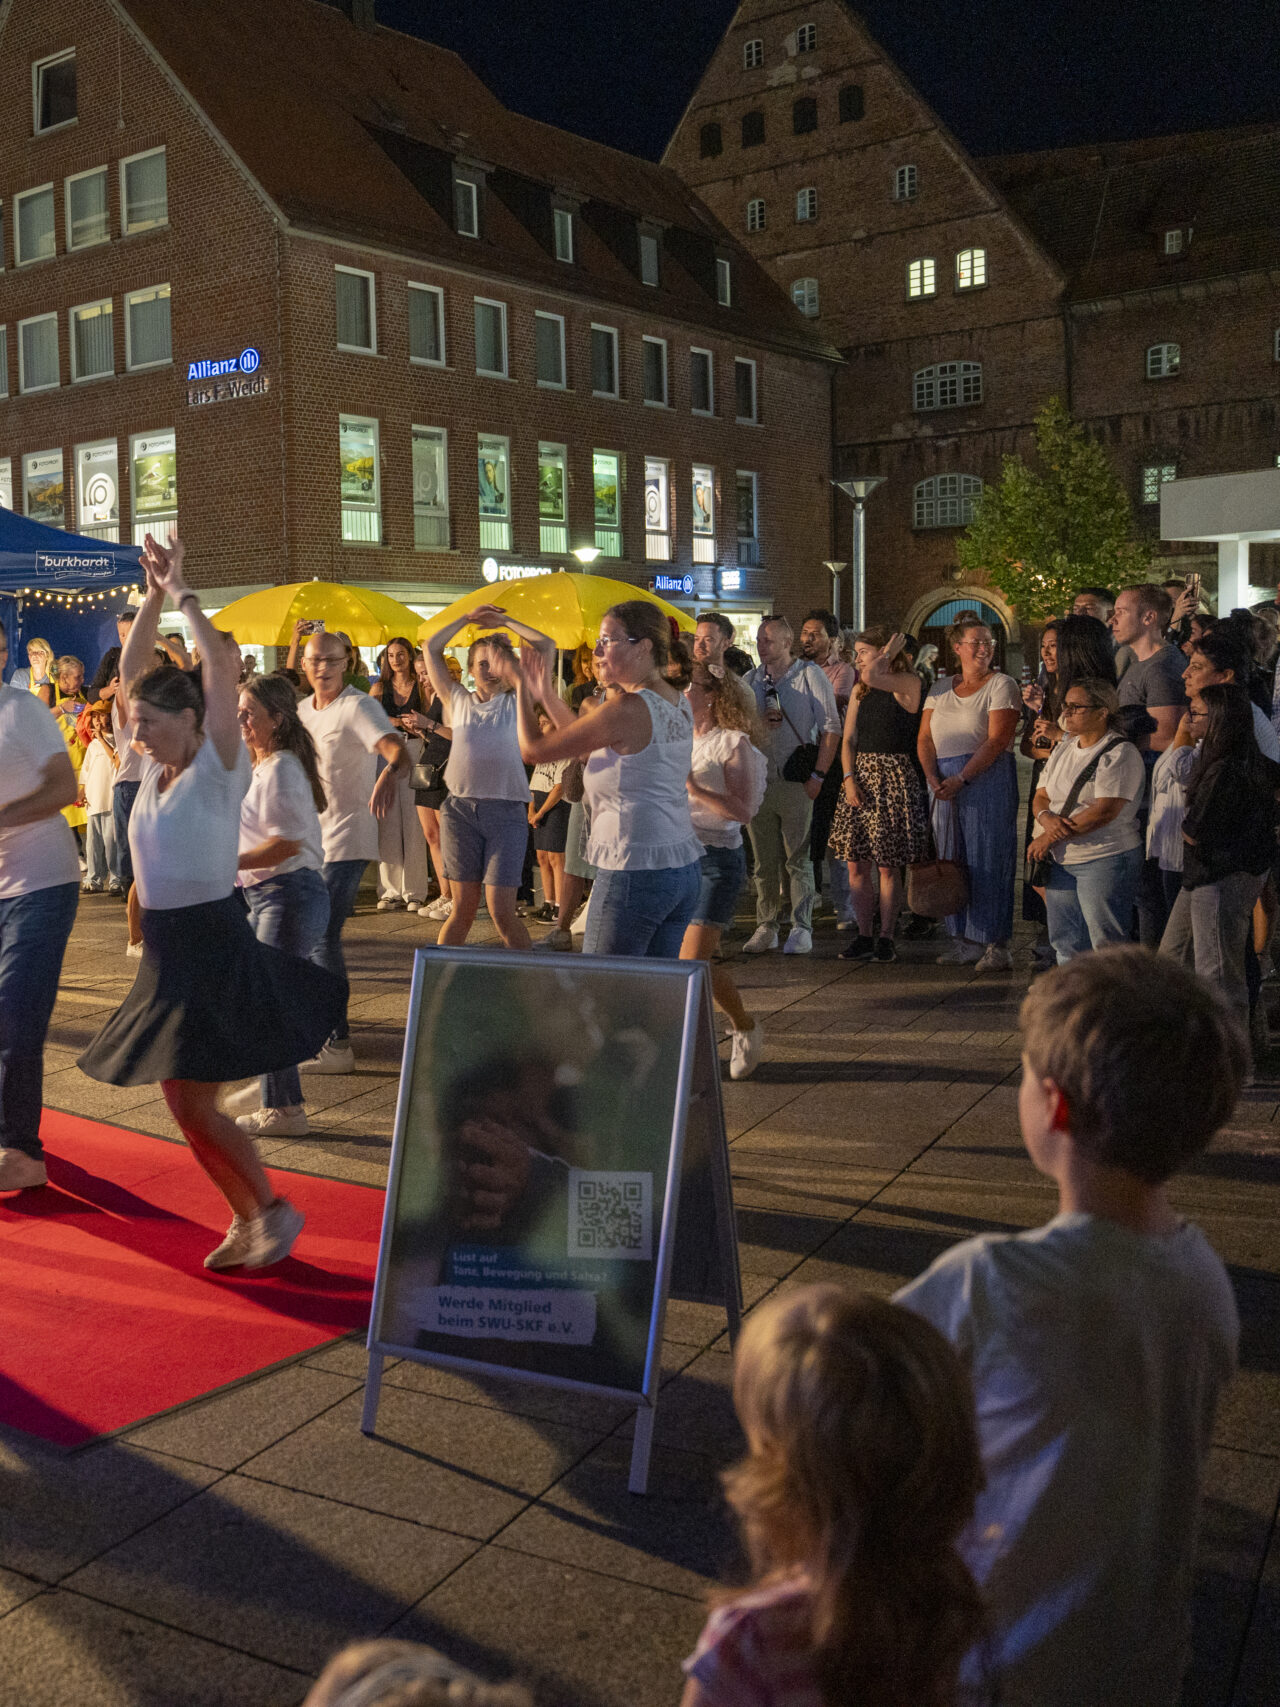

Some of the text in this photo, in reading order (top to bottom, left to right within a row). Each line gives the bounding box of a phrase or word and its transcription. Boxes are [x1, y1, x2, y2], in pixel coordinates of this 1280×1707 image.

[187, 359, 238, 380] Allianz
[185, 391, 211, 405] Lars
[227, 376, 266, 398] Weidt
[45, 555, 109, 567] burkhardt
[656, 575, 683, 590] Allianz
[453, 1252, 498, 1263] Lust auf
[483, 1268, 542, 1282] Bewegung
[546, 1271, 568, 1280] und
[438, 1296, 552, 1315] Werde Mitglied
[438, 1313, 575, 1334] beim SWU-SKF e.V.
